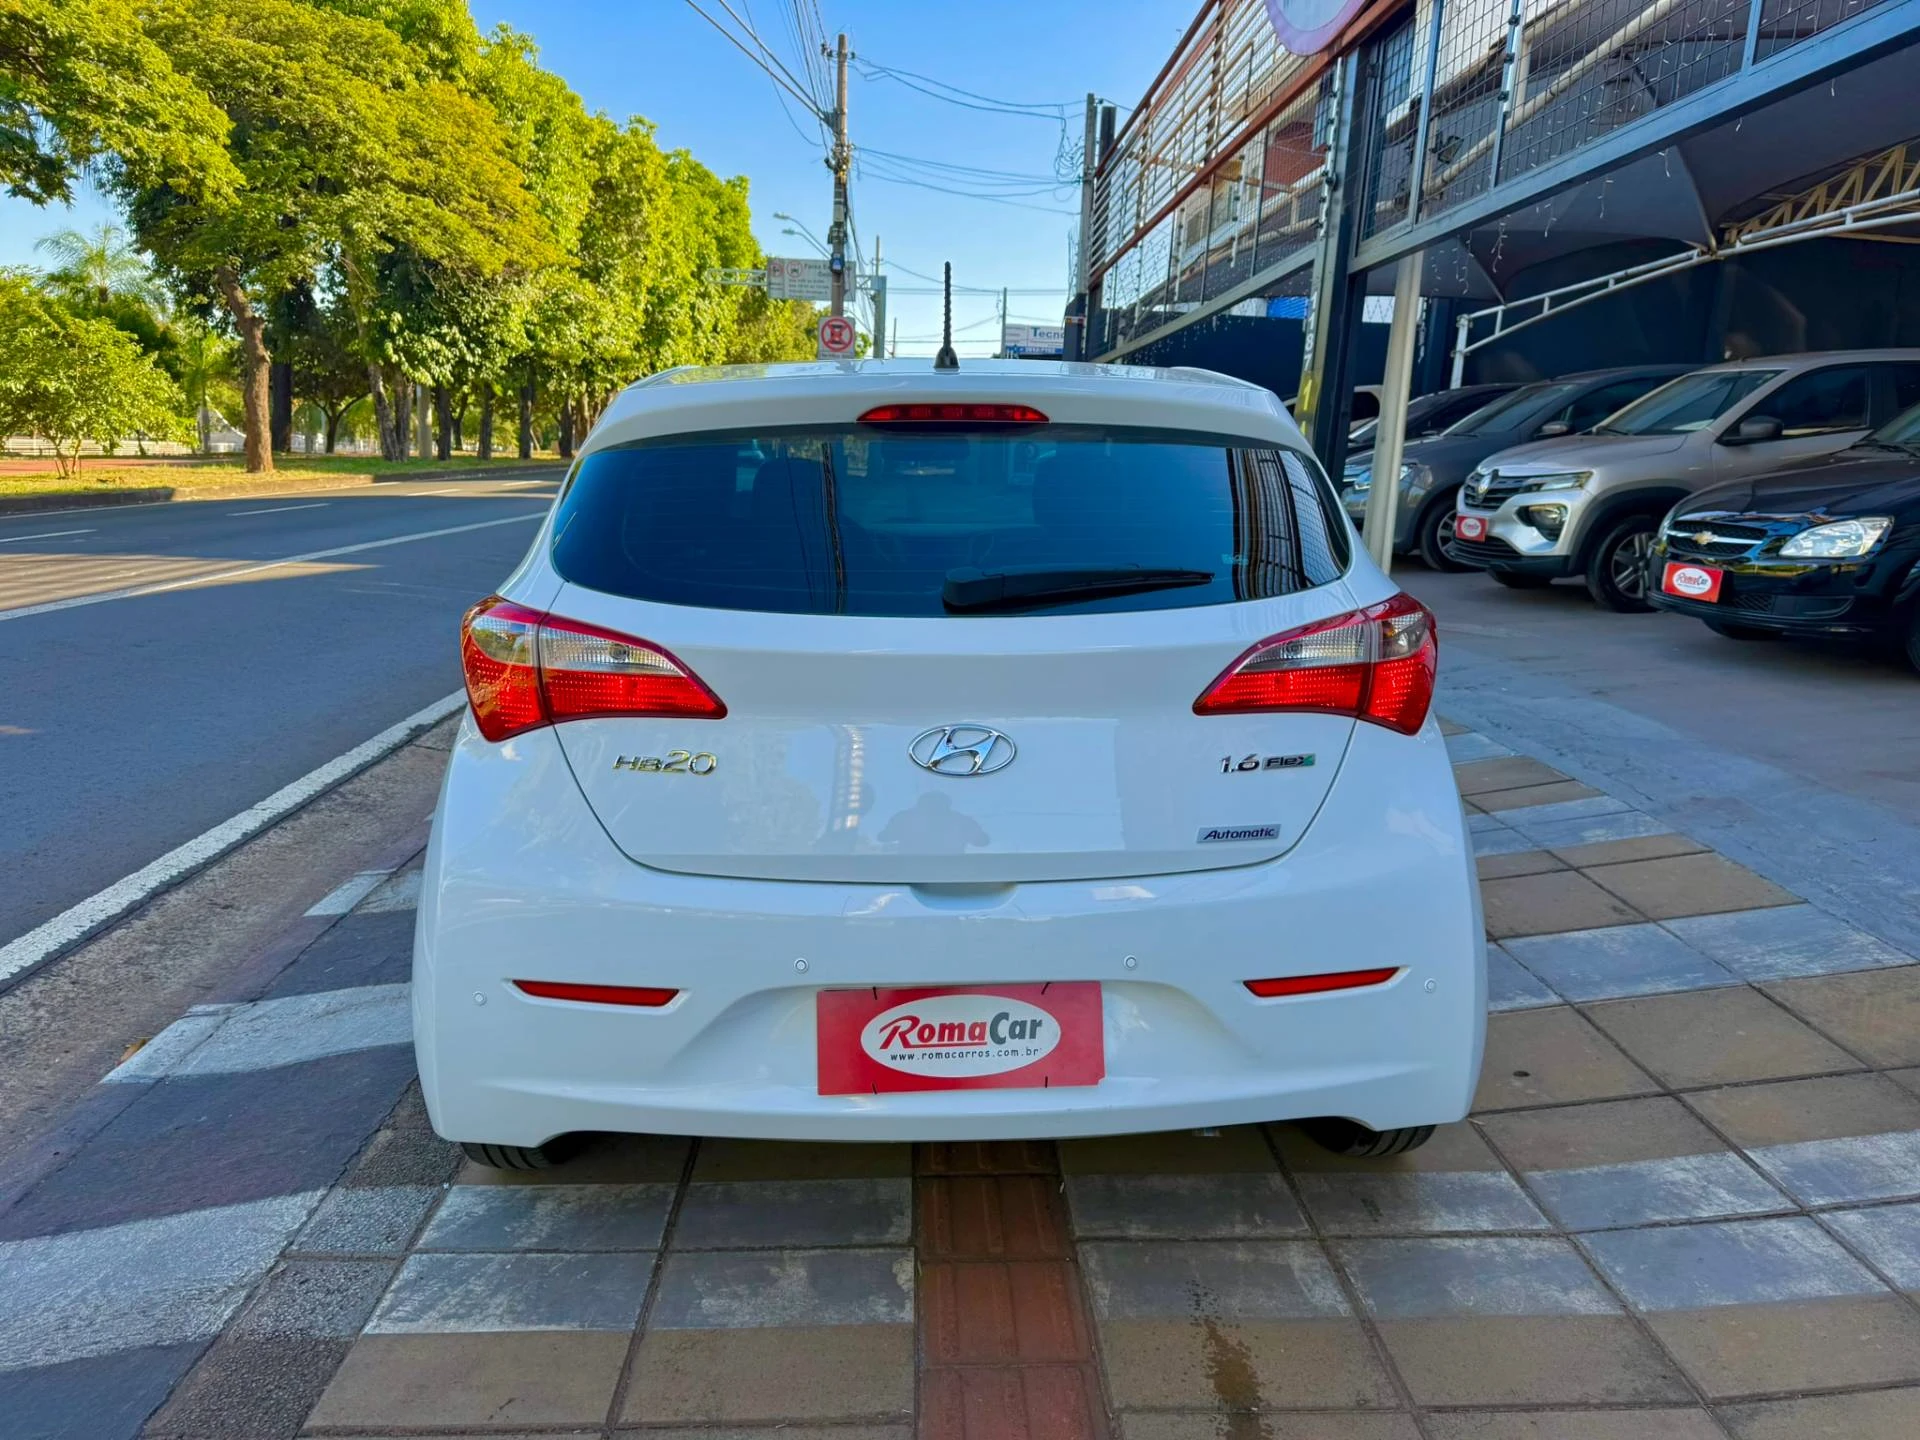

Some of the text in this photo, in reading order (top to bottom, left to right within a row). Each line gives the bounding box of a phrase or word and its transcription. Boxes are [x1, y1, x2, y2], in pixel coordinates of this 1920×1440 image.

[612, 750, 717, 775] HB20
[1220, 753, 1313, 773] 1.6 Flex
[1203, 827, 1275, 841] Automatic
[879, 1012, 1043, 1050] RomaCar
[890, 1047, 1040, 1061] www.romacarros.com.br
